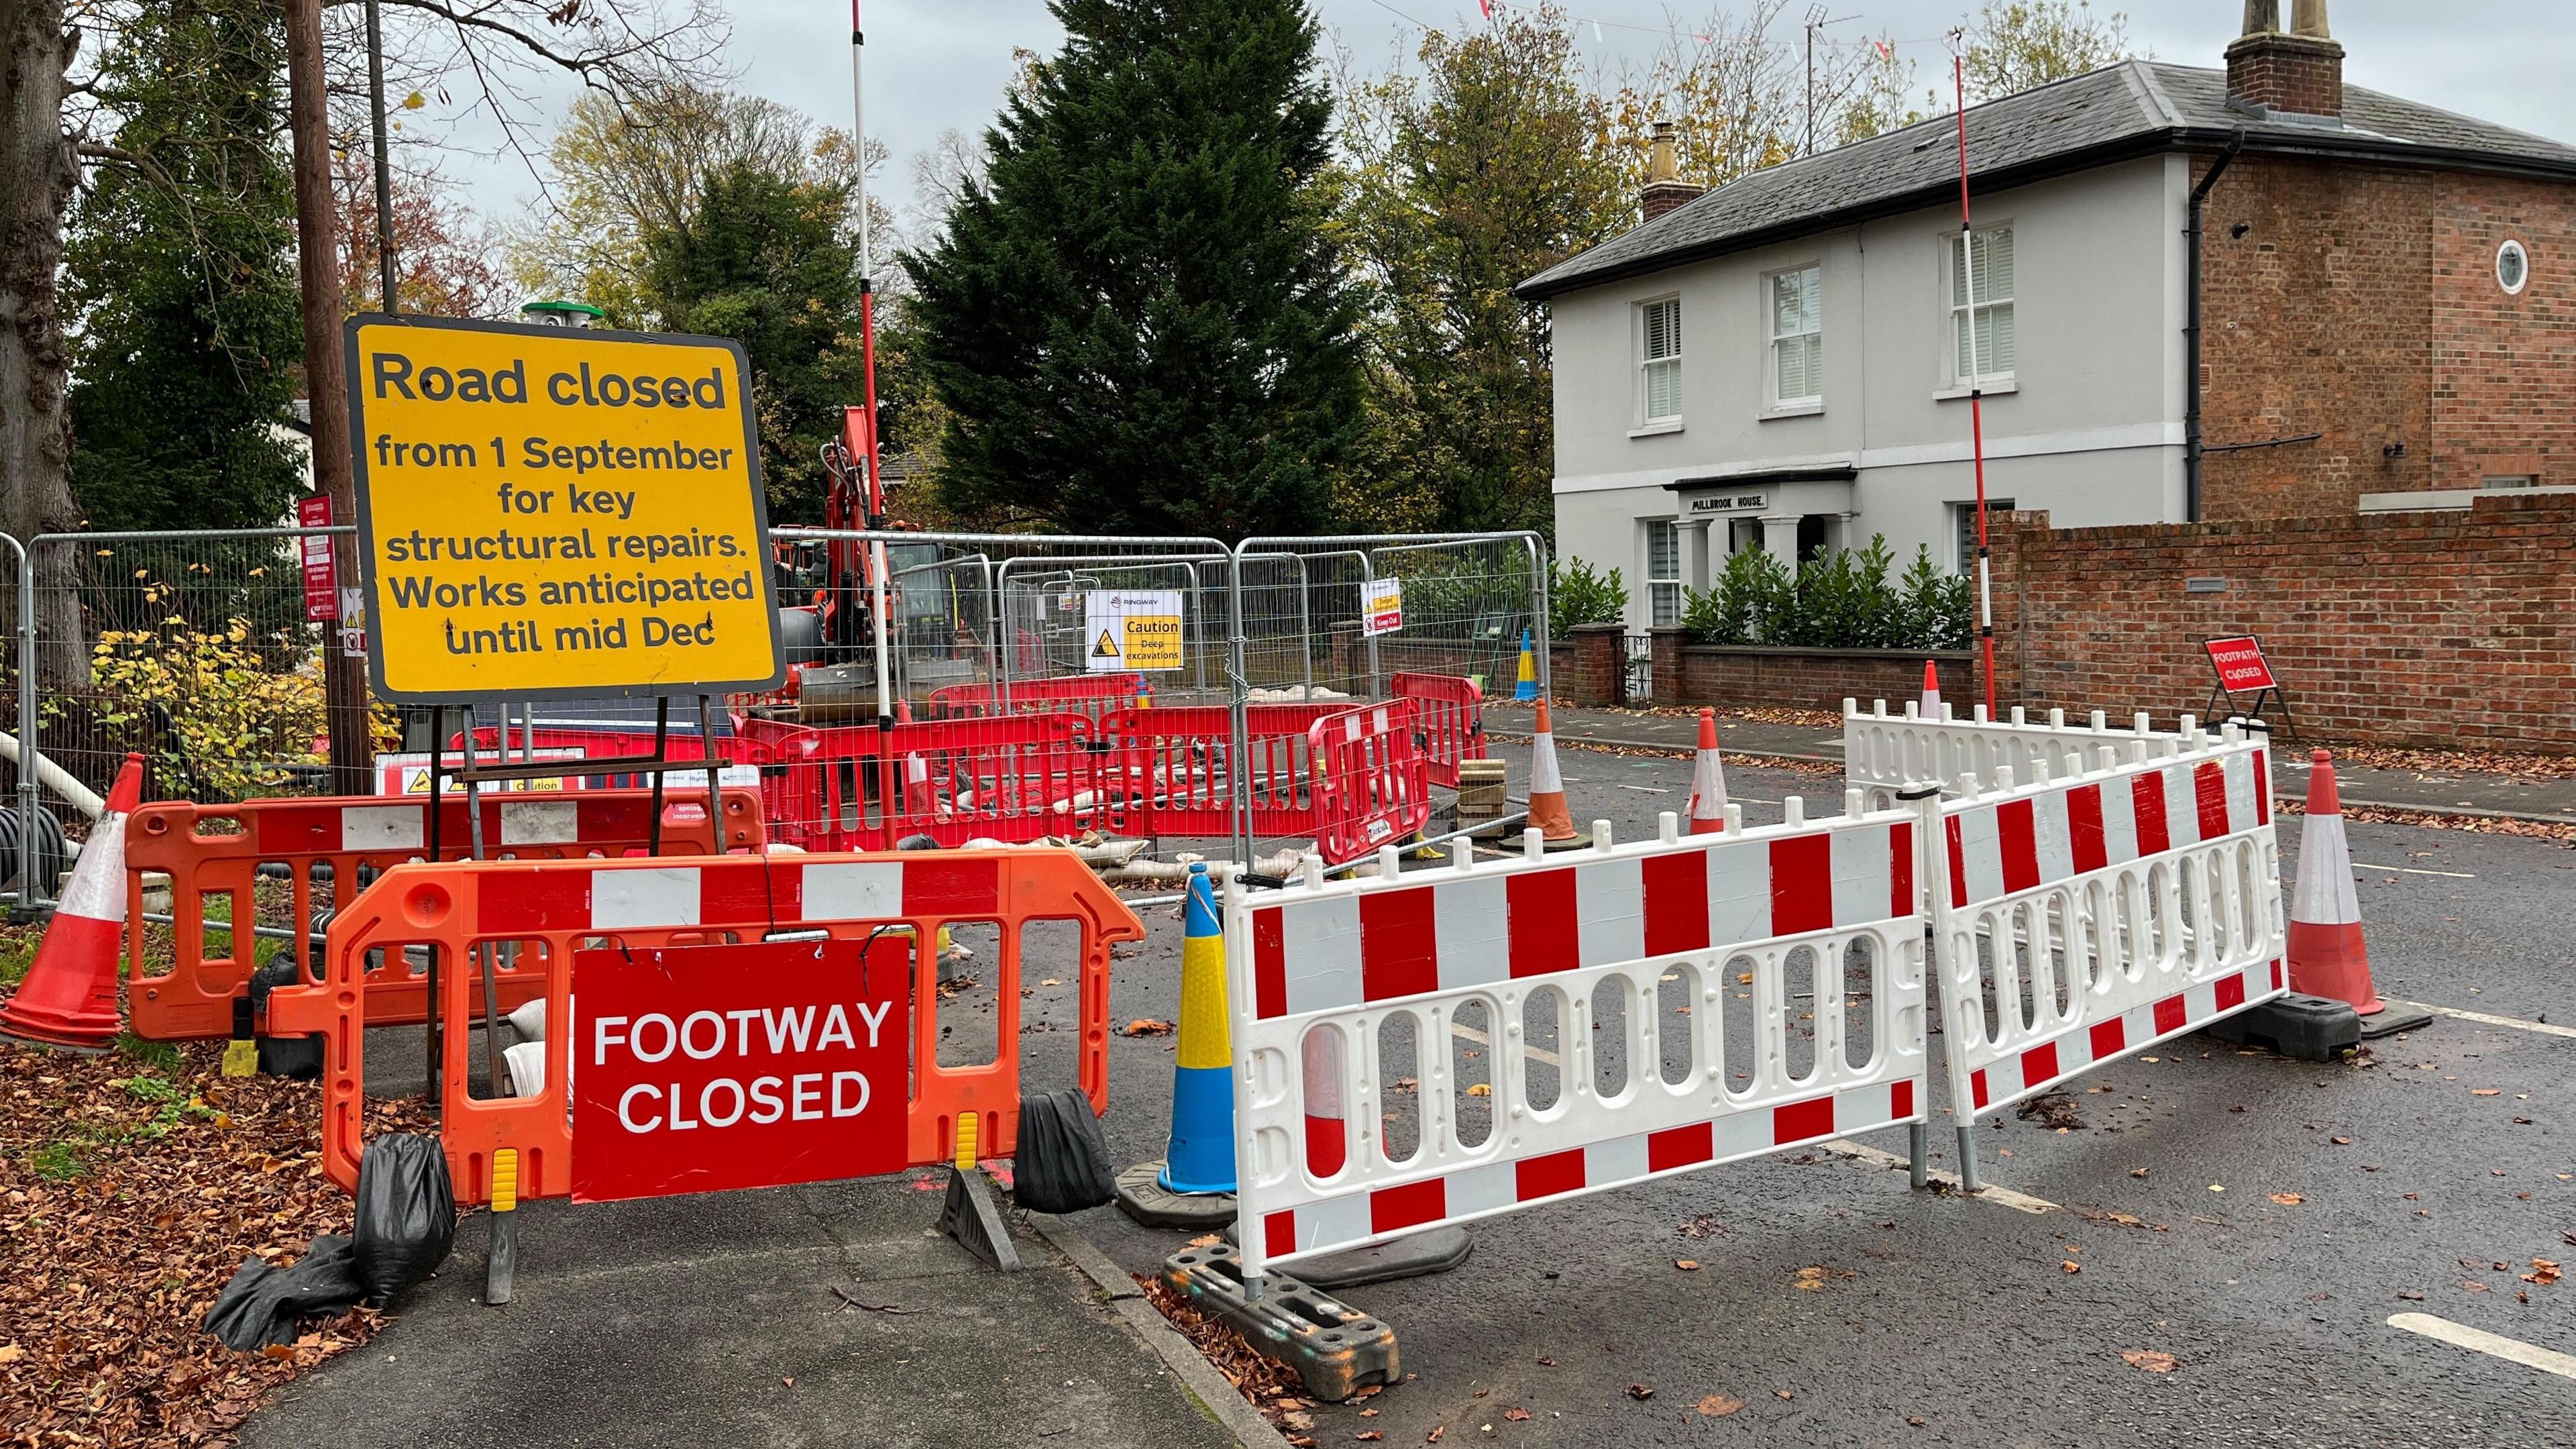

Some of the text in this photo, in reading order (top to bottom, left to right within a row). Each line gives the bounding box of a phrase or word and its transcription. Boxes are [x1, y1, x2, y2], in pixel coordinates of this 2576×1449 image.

[371, 352, 725, 410] Road closed
[374, 434, 733, 474] from 1 September
[497, 482, 636, 520] for key
[1692, 496, 1764, 511] MILLBROOK HOUSE.
[386, 527, 747, 564] structural repairs.
[388, 571, 754, 609] Works anticipated
[446, 616, 716, 655] until mid Dec
[1127, 621, 1178, 633] Caution
[1141, 640, 1164, 649] Deep
[1126, 651, 1179, 660] excavations
[2212, 649, 2259, 663] FOOTPATH
[2225, 666, 2261, 680] CLOSED
[517, 782, 557, 791] Ction
[594, 1000, 893, 1066] FOOTWAY
[619, 1071, 871, 1134] CLOSED
